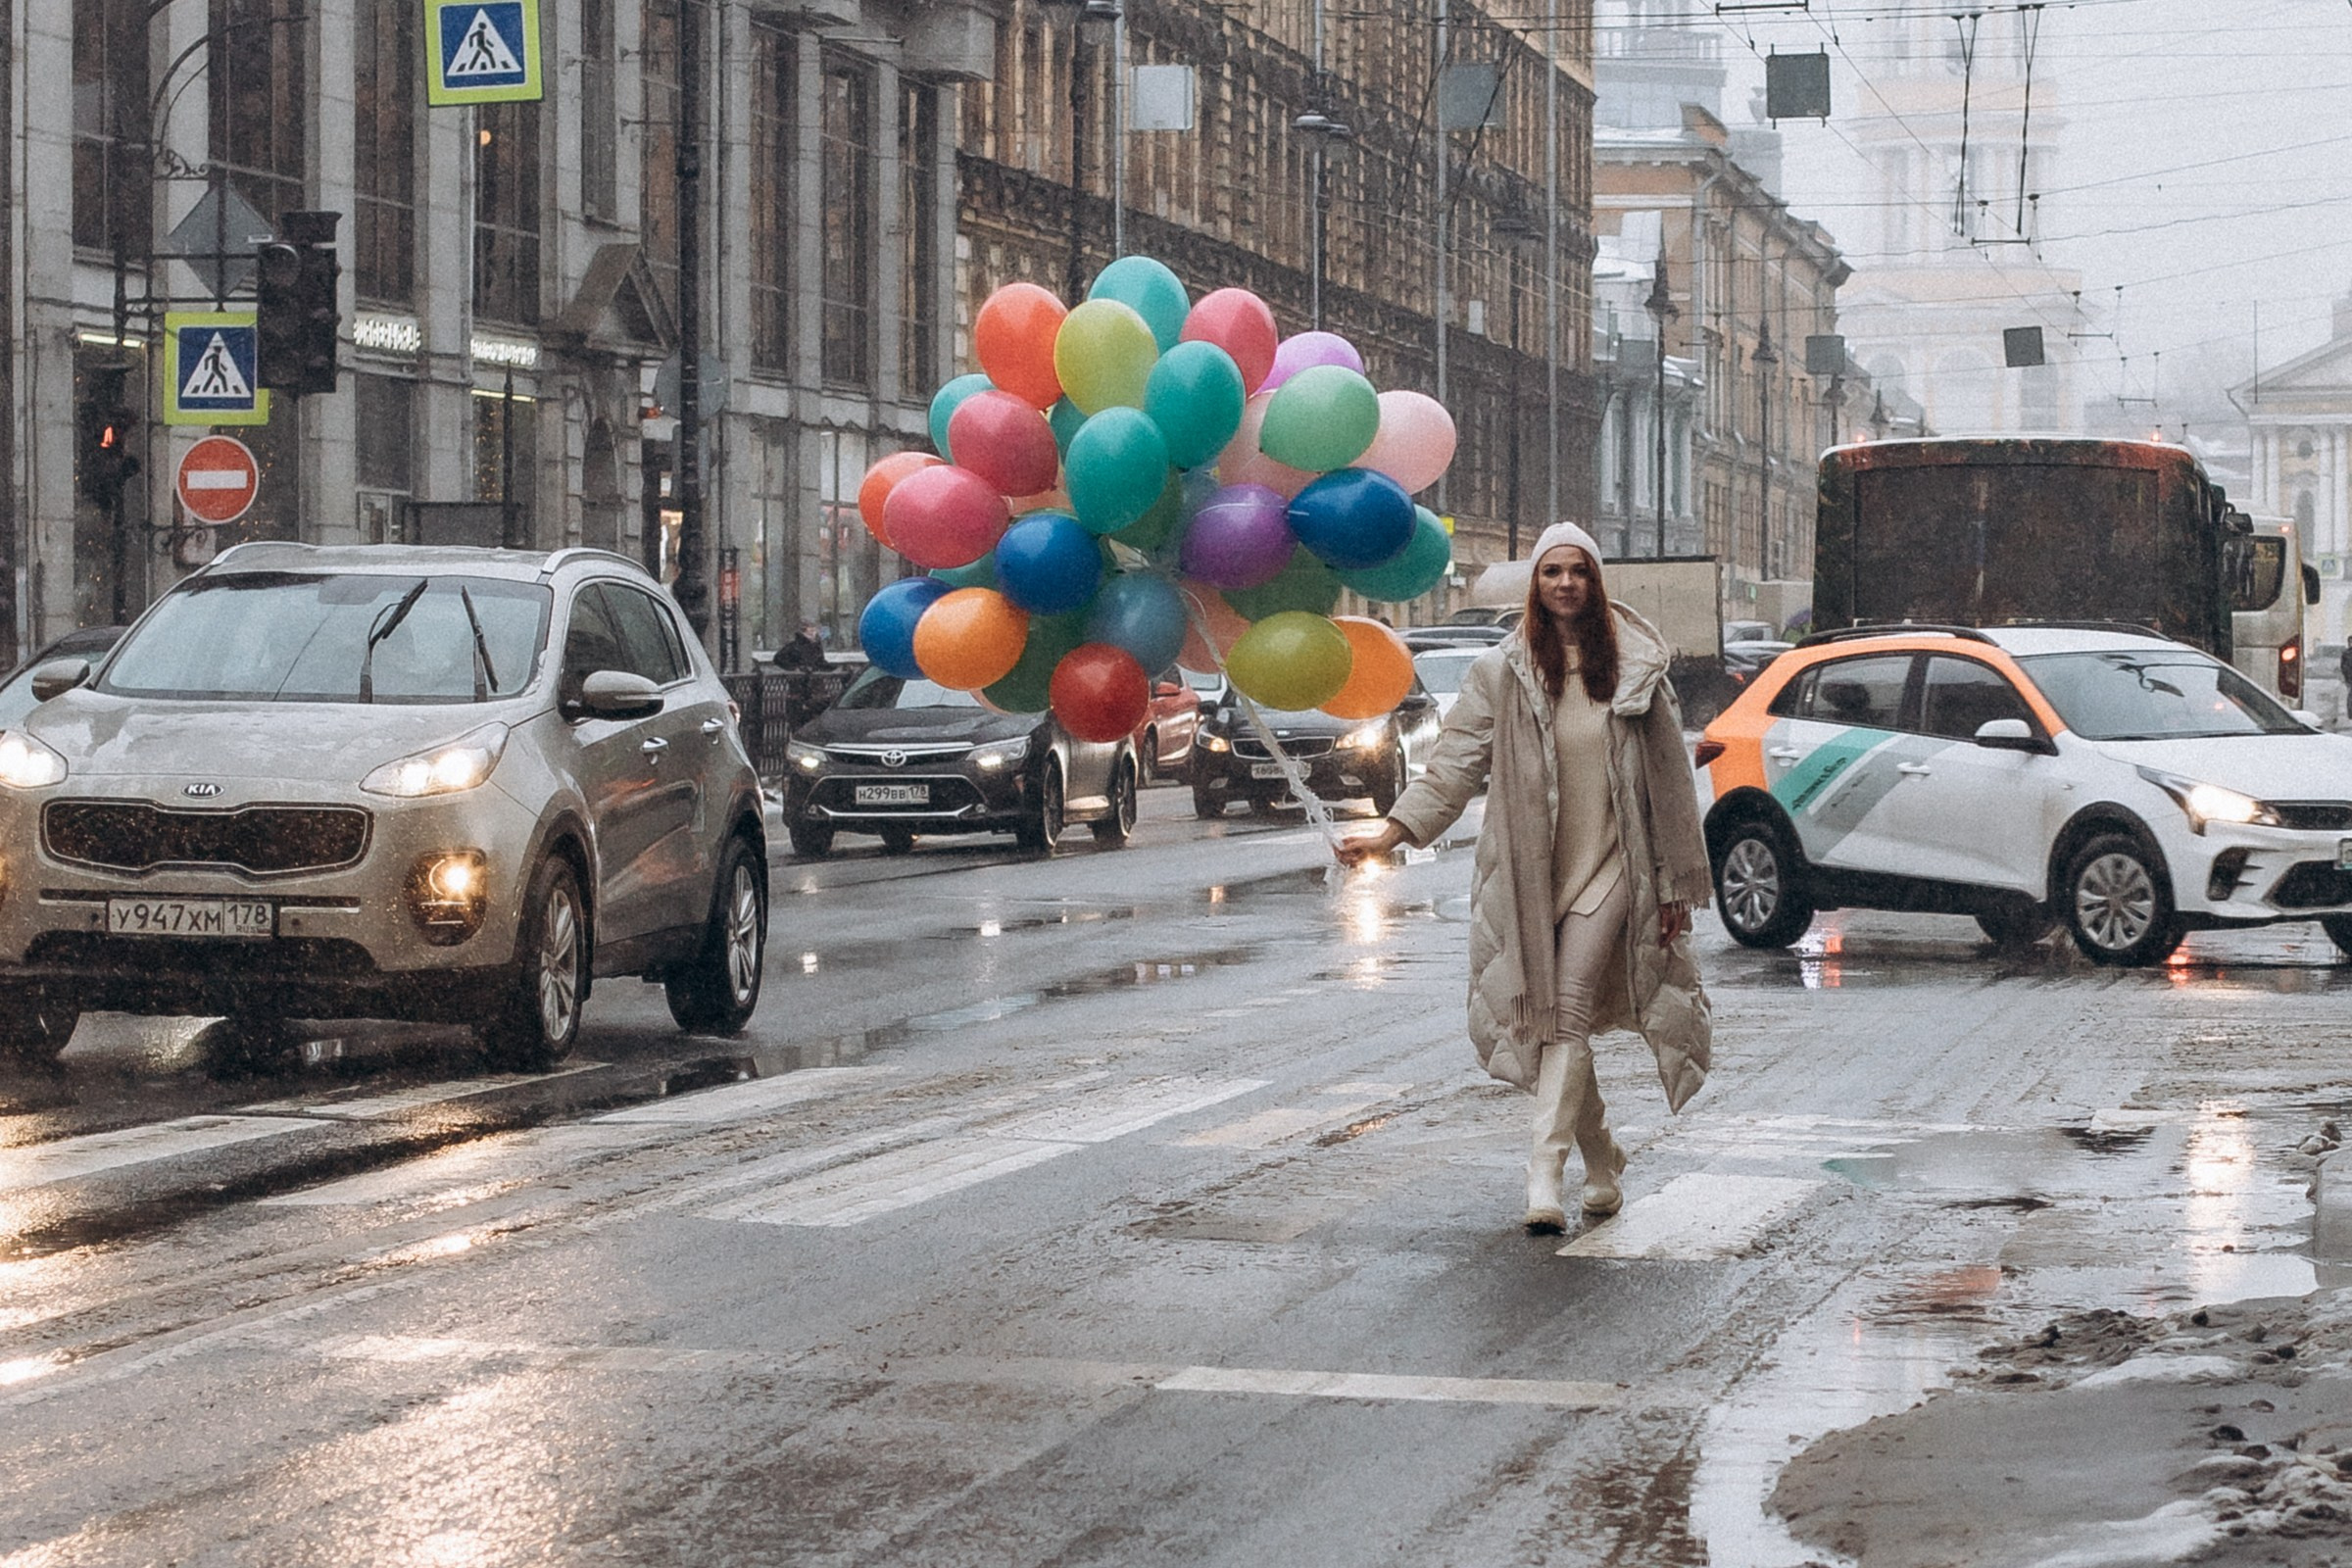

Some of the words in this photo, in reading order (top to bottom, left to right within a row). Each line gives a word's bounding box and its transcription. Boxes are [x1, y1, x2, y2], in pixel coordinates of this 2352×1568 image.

[187, 784, 216, 795] KIA
[117, 903, 221, 931] У947ХМ
[227, 903, 267, 925] 178
